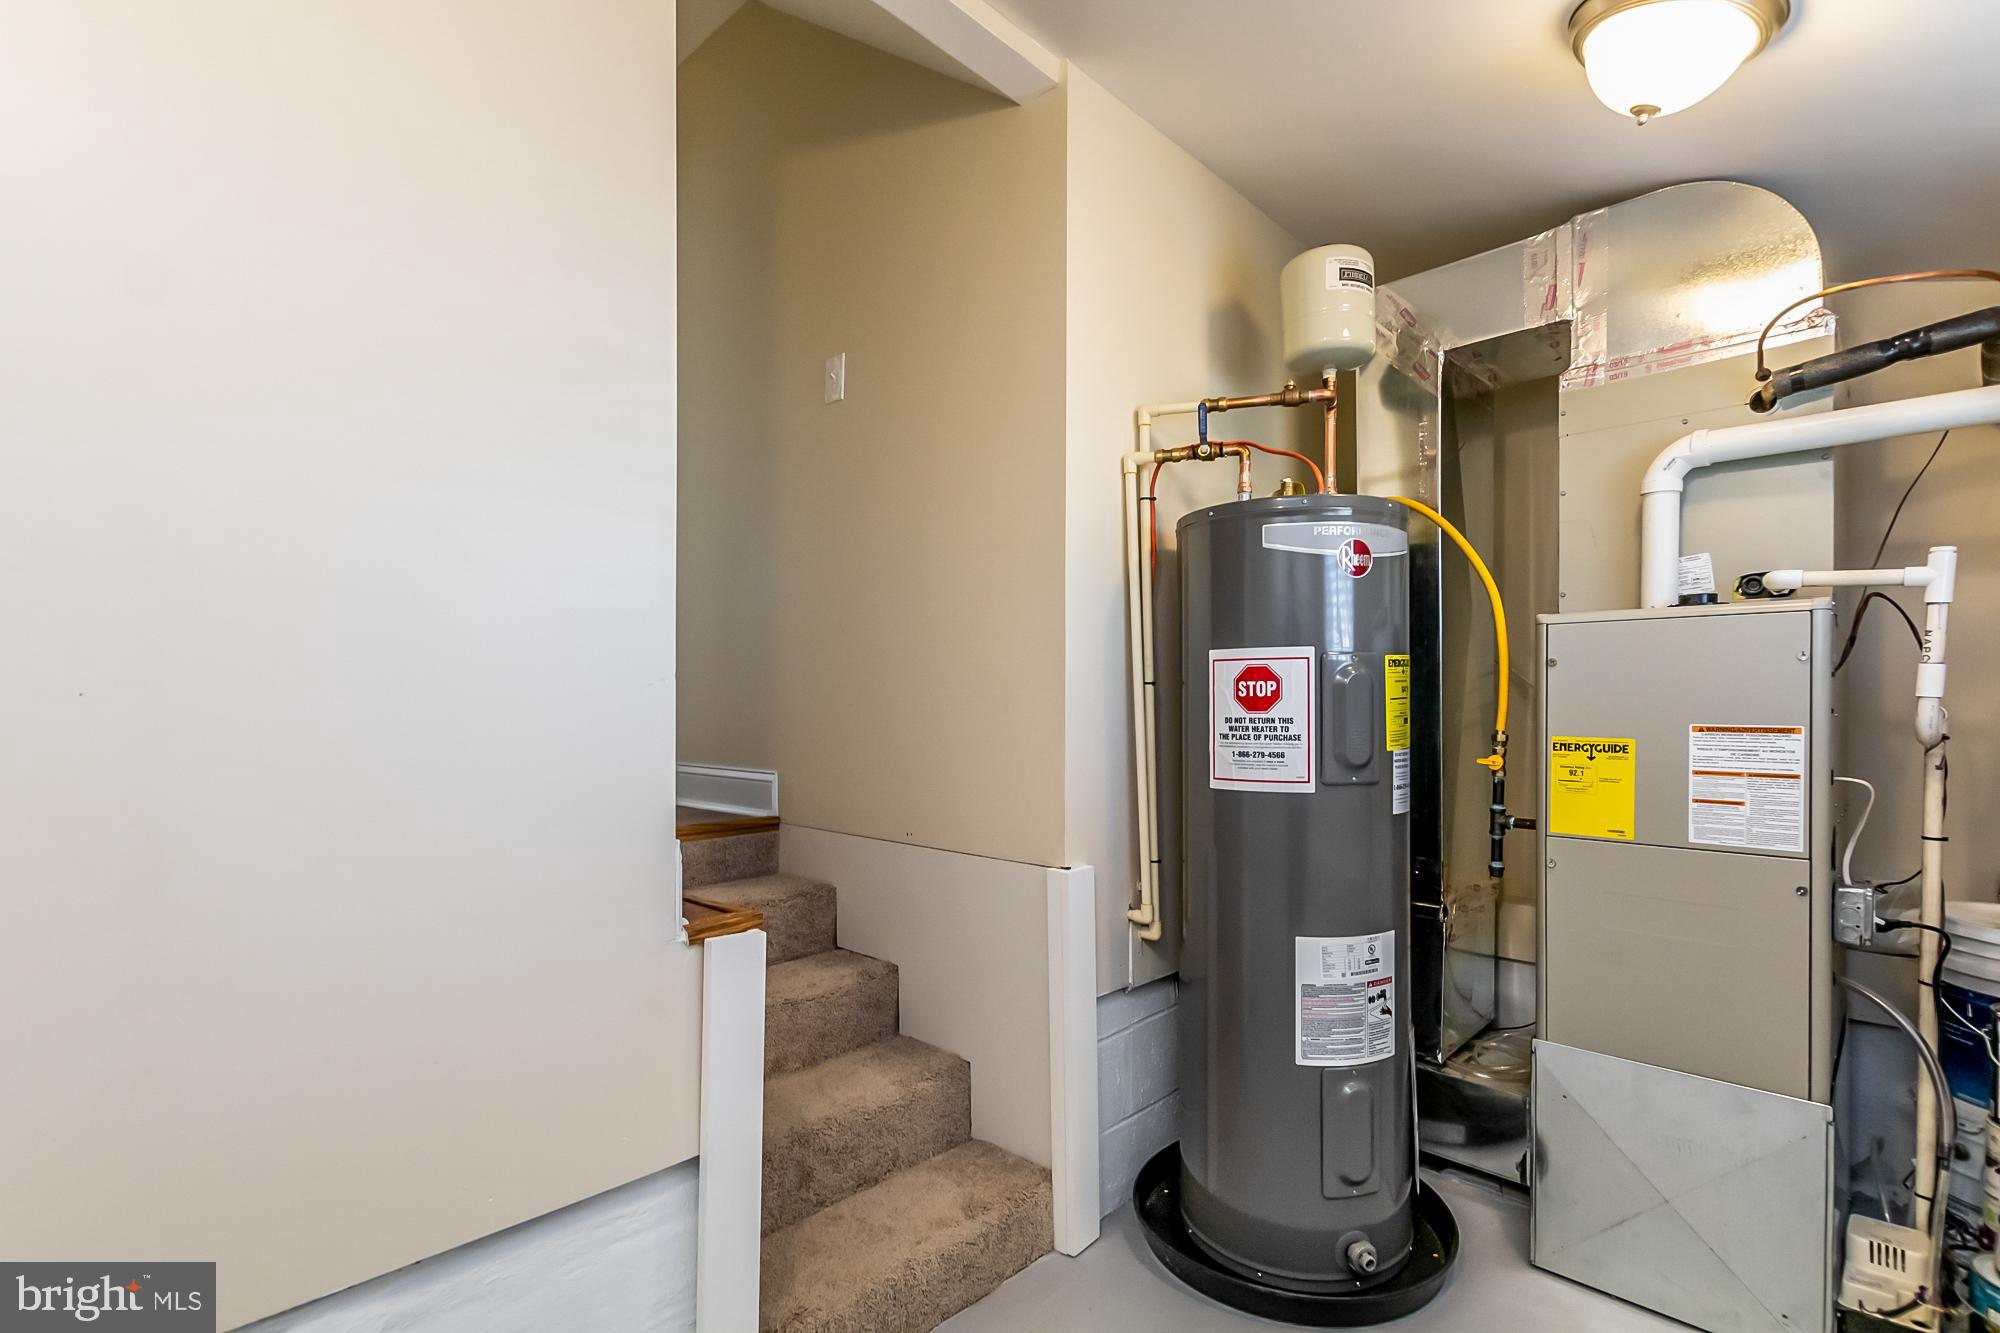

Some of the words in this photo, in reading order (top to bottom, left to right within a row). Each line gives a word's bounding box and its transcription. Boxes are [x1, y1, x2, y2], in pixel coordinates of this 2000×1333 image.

[1341, 540, 1371, 573] Rheem
[1238, 680, 1277, 697] STOP
[1228, 725, 1250, 733] WATER
[1251, 725, 1278, 733] HEATER
[1280, 725, 1290, 733] TO
[1219, 733, 1230, 741] THE
[1231, 733, 1252, 741] PLACE
[1254, 733, 1262, 741] OF
[1264, 733, 1302, 741] PURCHASE
[1552, 742, 1630, 755] ENERGYGUIDE
[1568, 769, 1584, 777] 92.1
